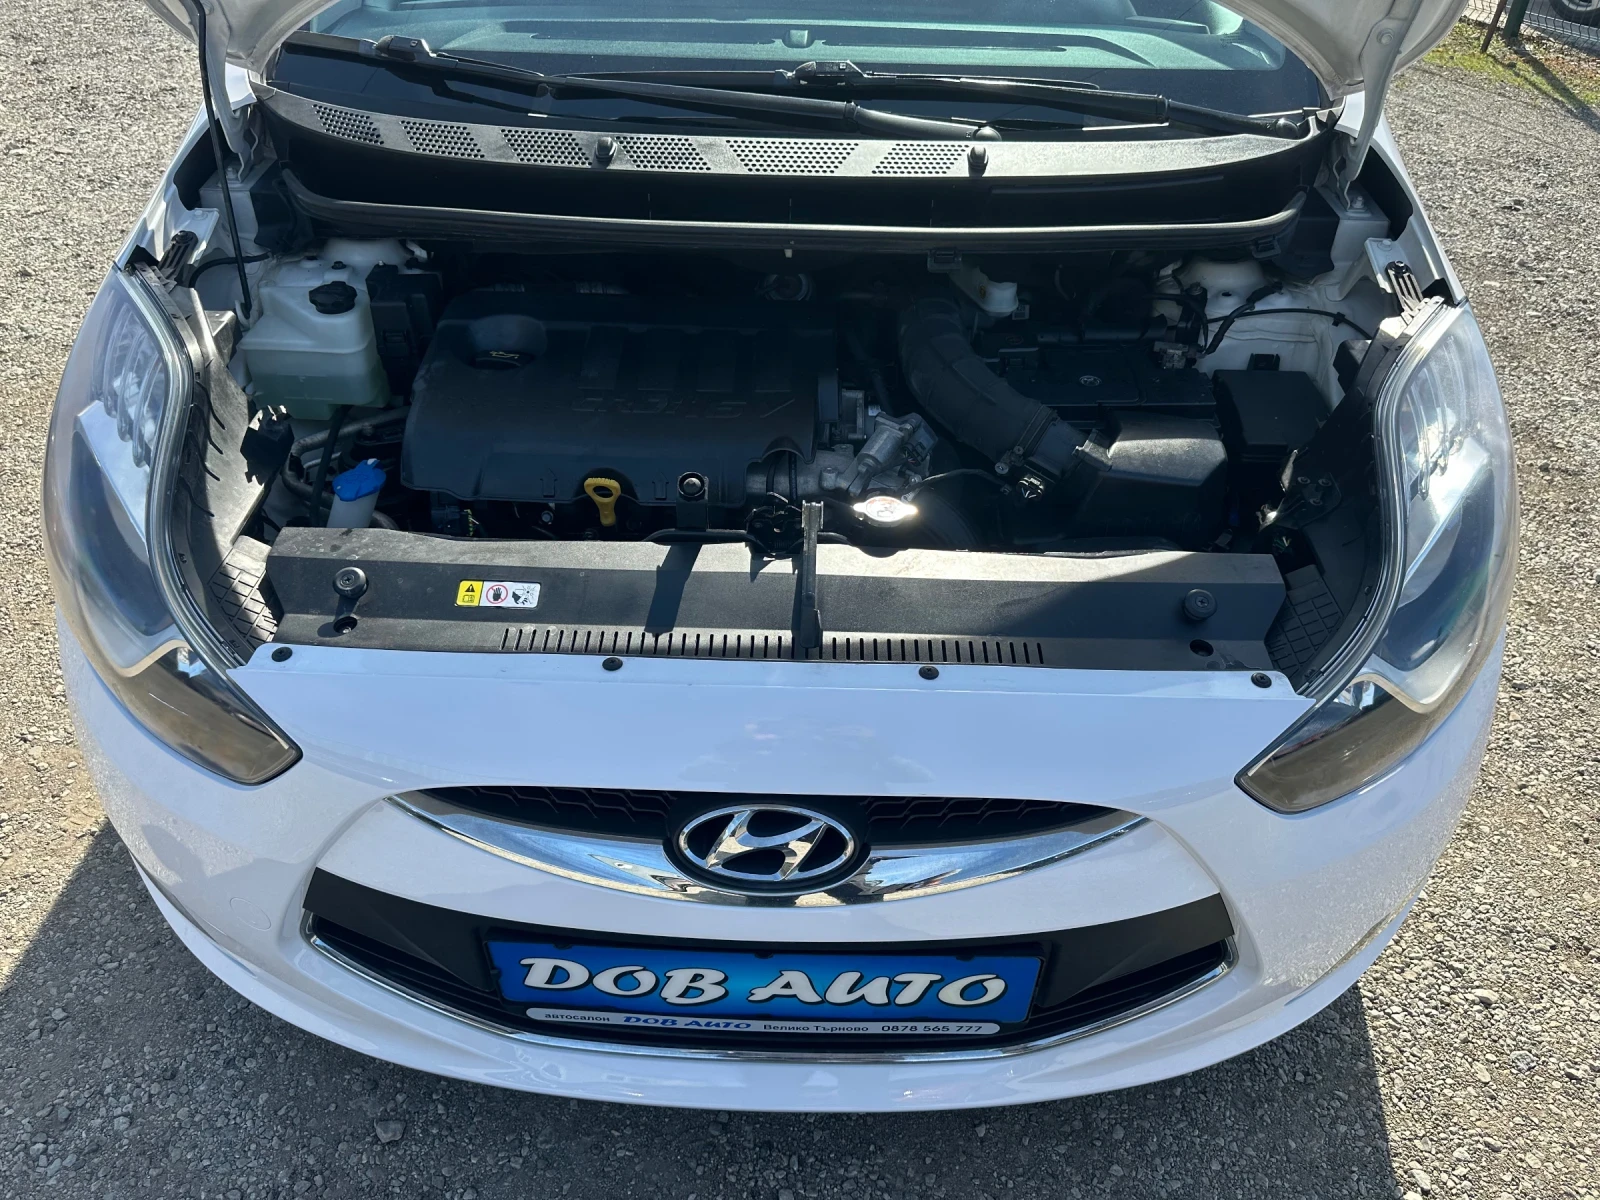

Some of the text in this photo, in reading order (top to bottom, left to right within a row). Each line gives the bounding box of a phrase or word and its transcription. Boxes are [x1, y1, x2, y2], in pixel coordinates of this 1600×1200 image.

[519, 957, 1008, 1006] DOB AUTO
[544, 1012, 611, 1023] автосалон
[622, 1015, 678, 1027] DOB
[683, 1019, 752, 1030] AUTO
[763, 1023, 810, 1032] Велико
[814, 1025, 869, 1033] Търново
[881, 1024, 919, 1033] 0878
[922, 1024, 950, 1032] 565
